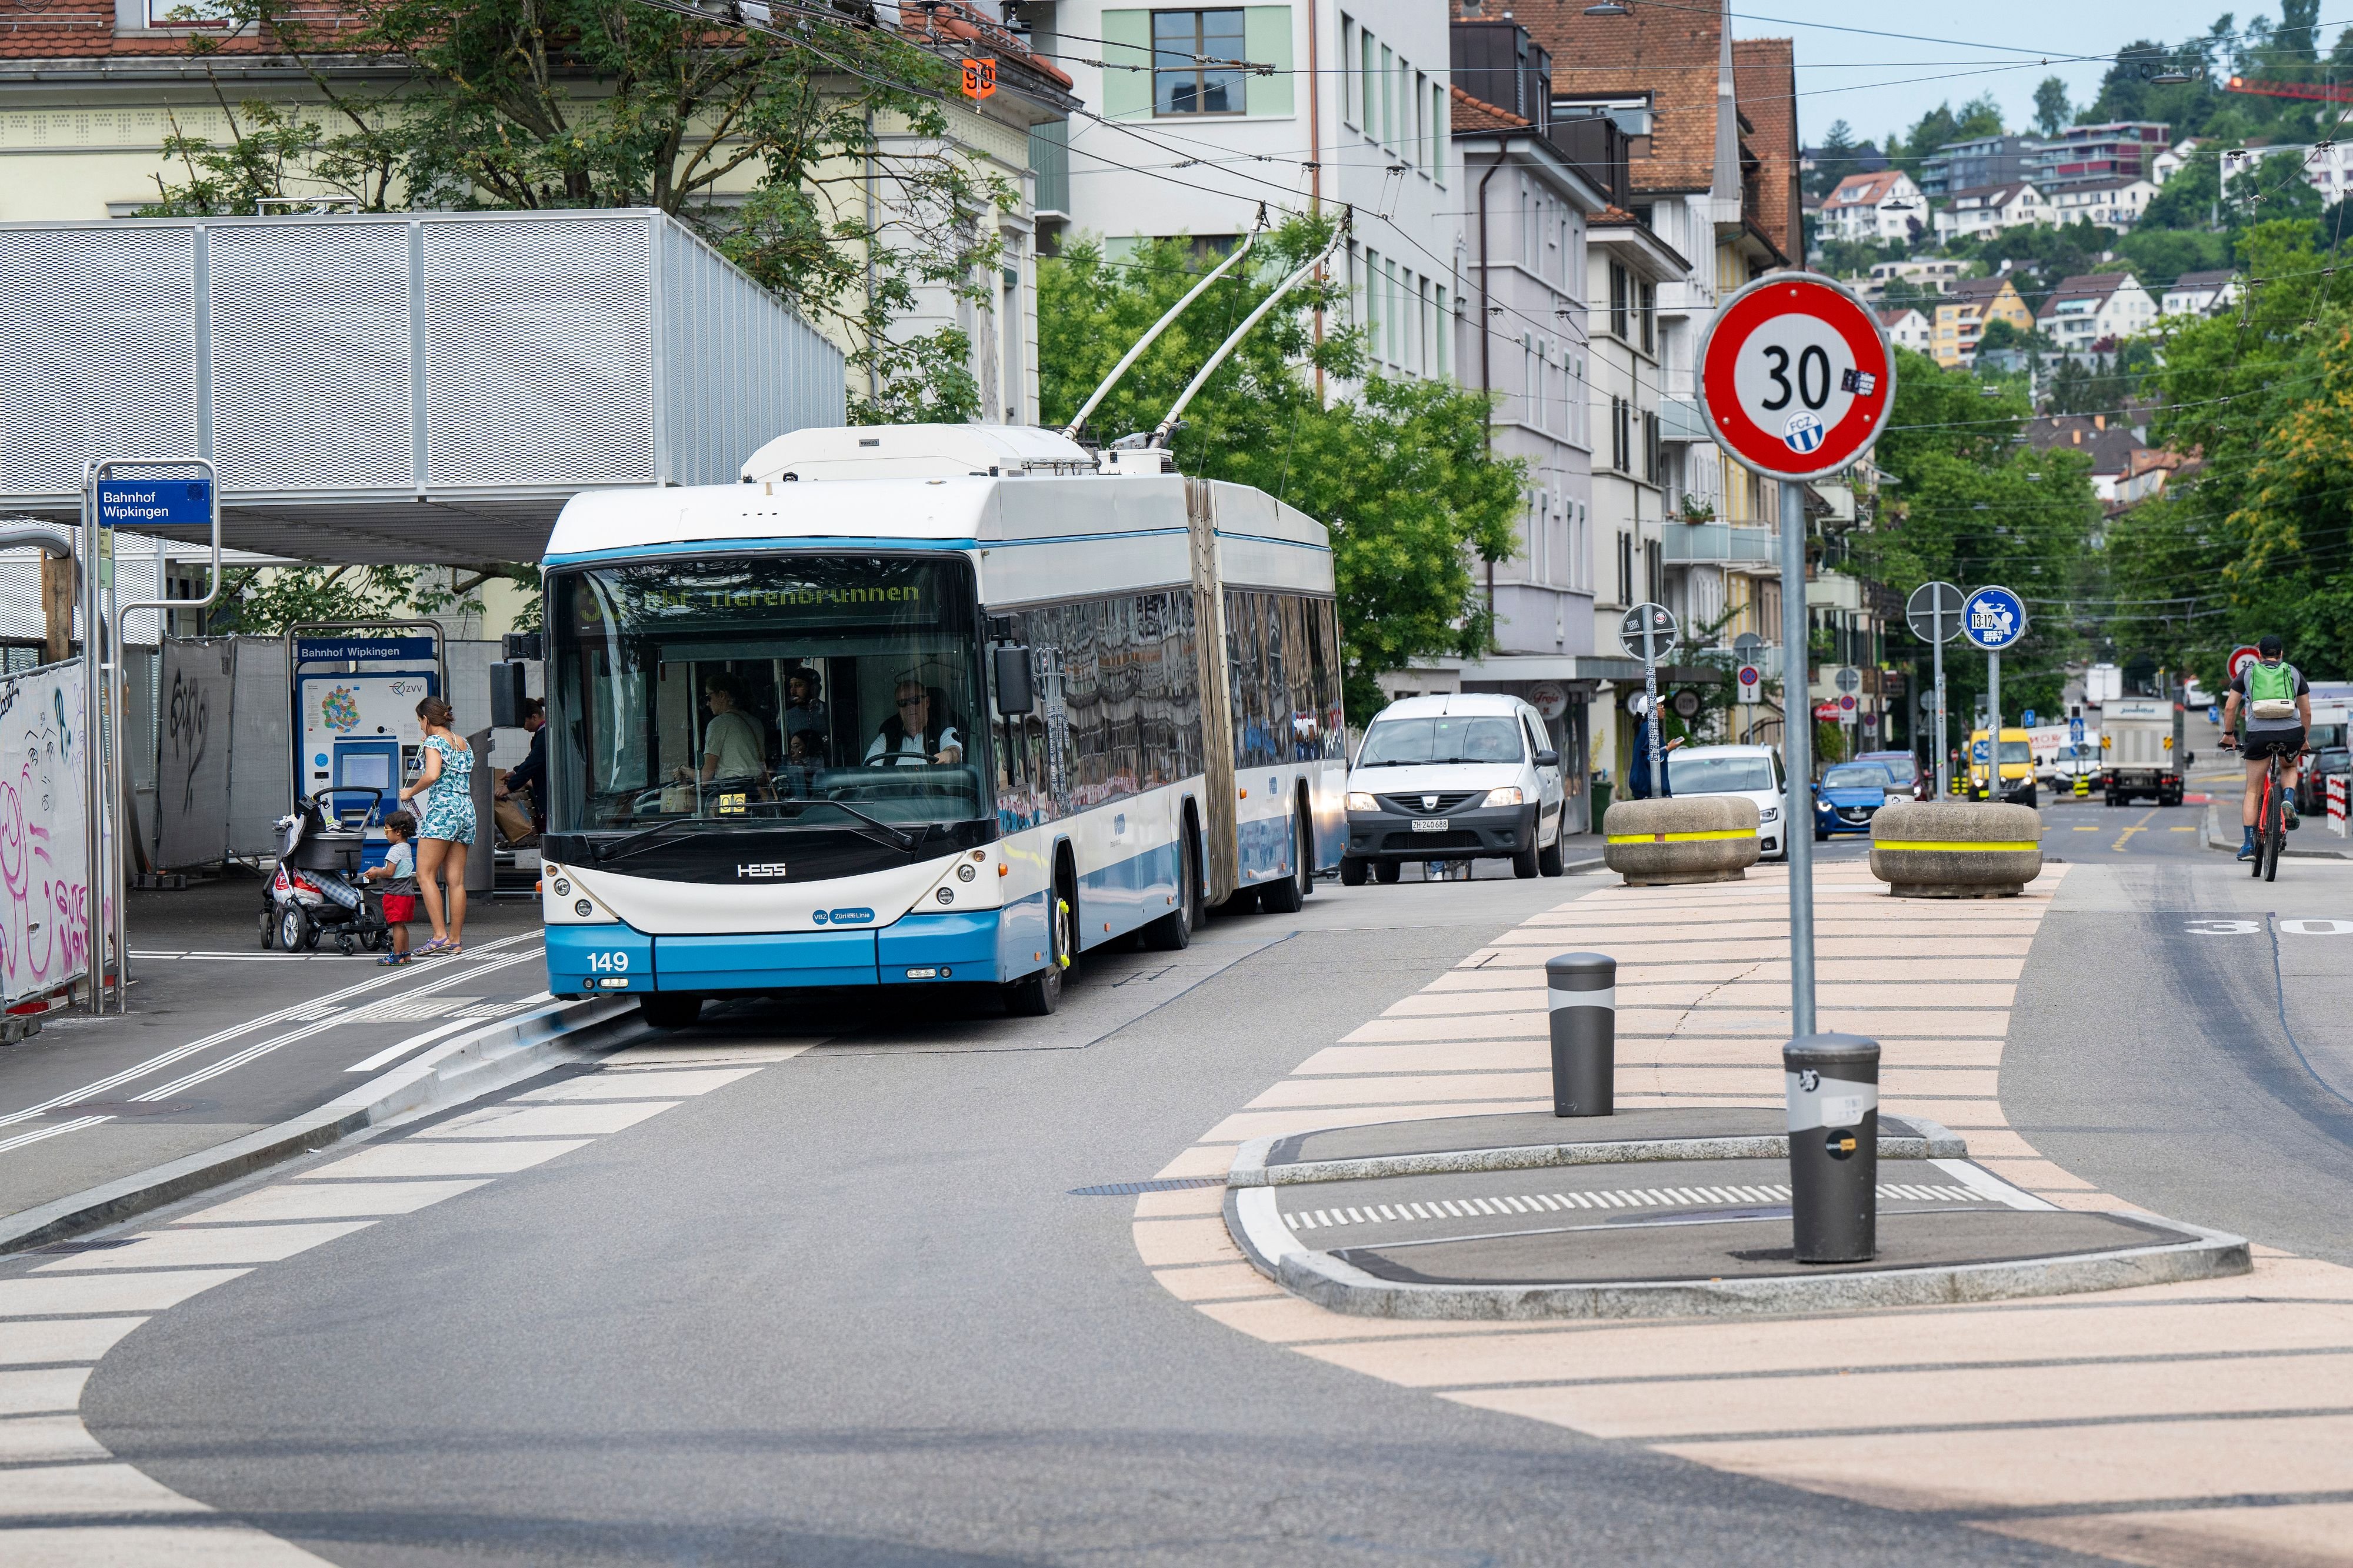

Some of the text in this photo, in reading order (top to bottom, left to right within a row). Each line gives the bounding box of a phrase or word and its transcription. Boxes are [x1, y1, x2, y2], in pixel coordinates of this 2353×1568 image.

[1762, 345, 1830, 410] 30
[1790, 416, 1812, 431] FCZ
[104, 492, 156, 503] Bahnhof
[104, 506, 169, 519] Wipkingen
[706, 585, 919, 608] Tiefenbrunnen
[1972, 615, 1992, 628] 13:12
[302, 648, 400, 658] Bahnhof Wipkingen
[722, 796, 744, 810] 06
[738, 863, 786, 877] HESS
[587, 952, 628, 972] 149
